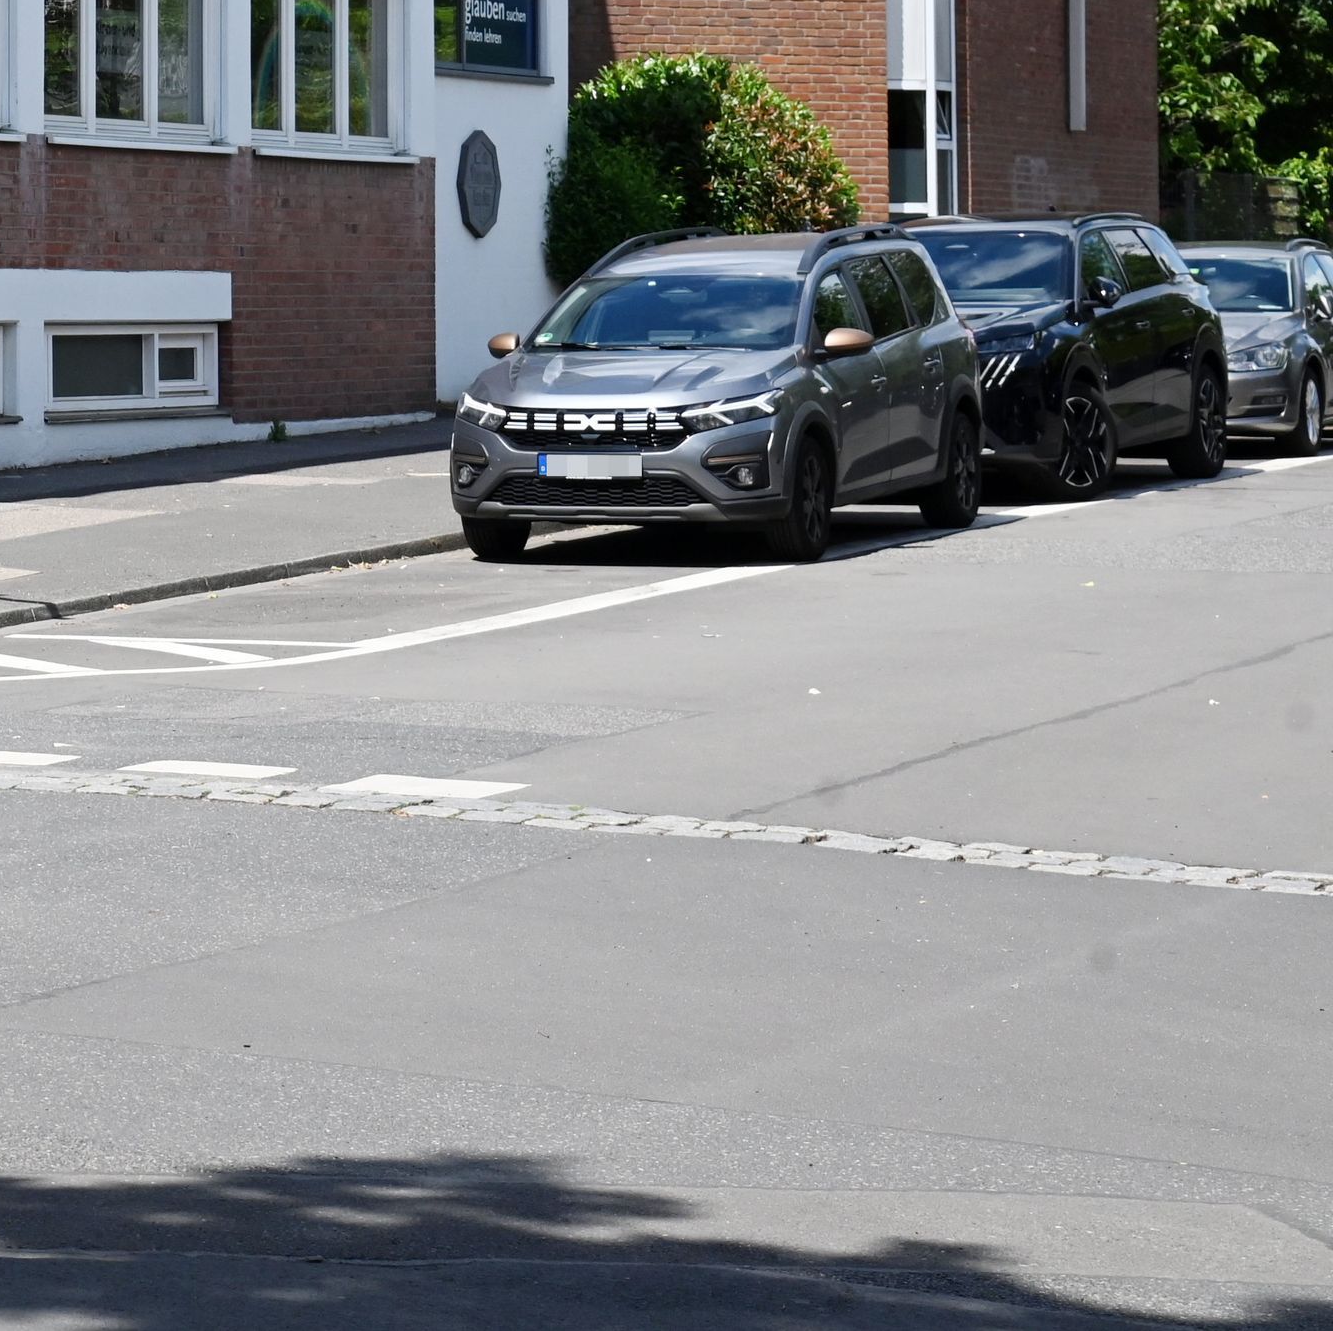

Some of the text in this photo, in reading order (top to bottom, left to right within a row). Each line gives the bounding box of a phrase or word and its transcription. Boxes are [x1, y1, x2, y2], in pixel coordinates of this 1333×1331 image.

[506, 7, 526, 22] suchen
[465, 26, 501, 44] finden lehren
